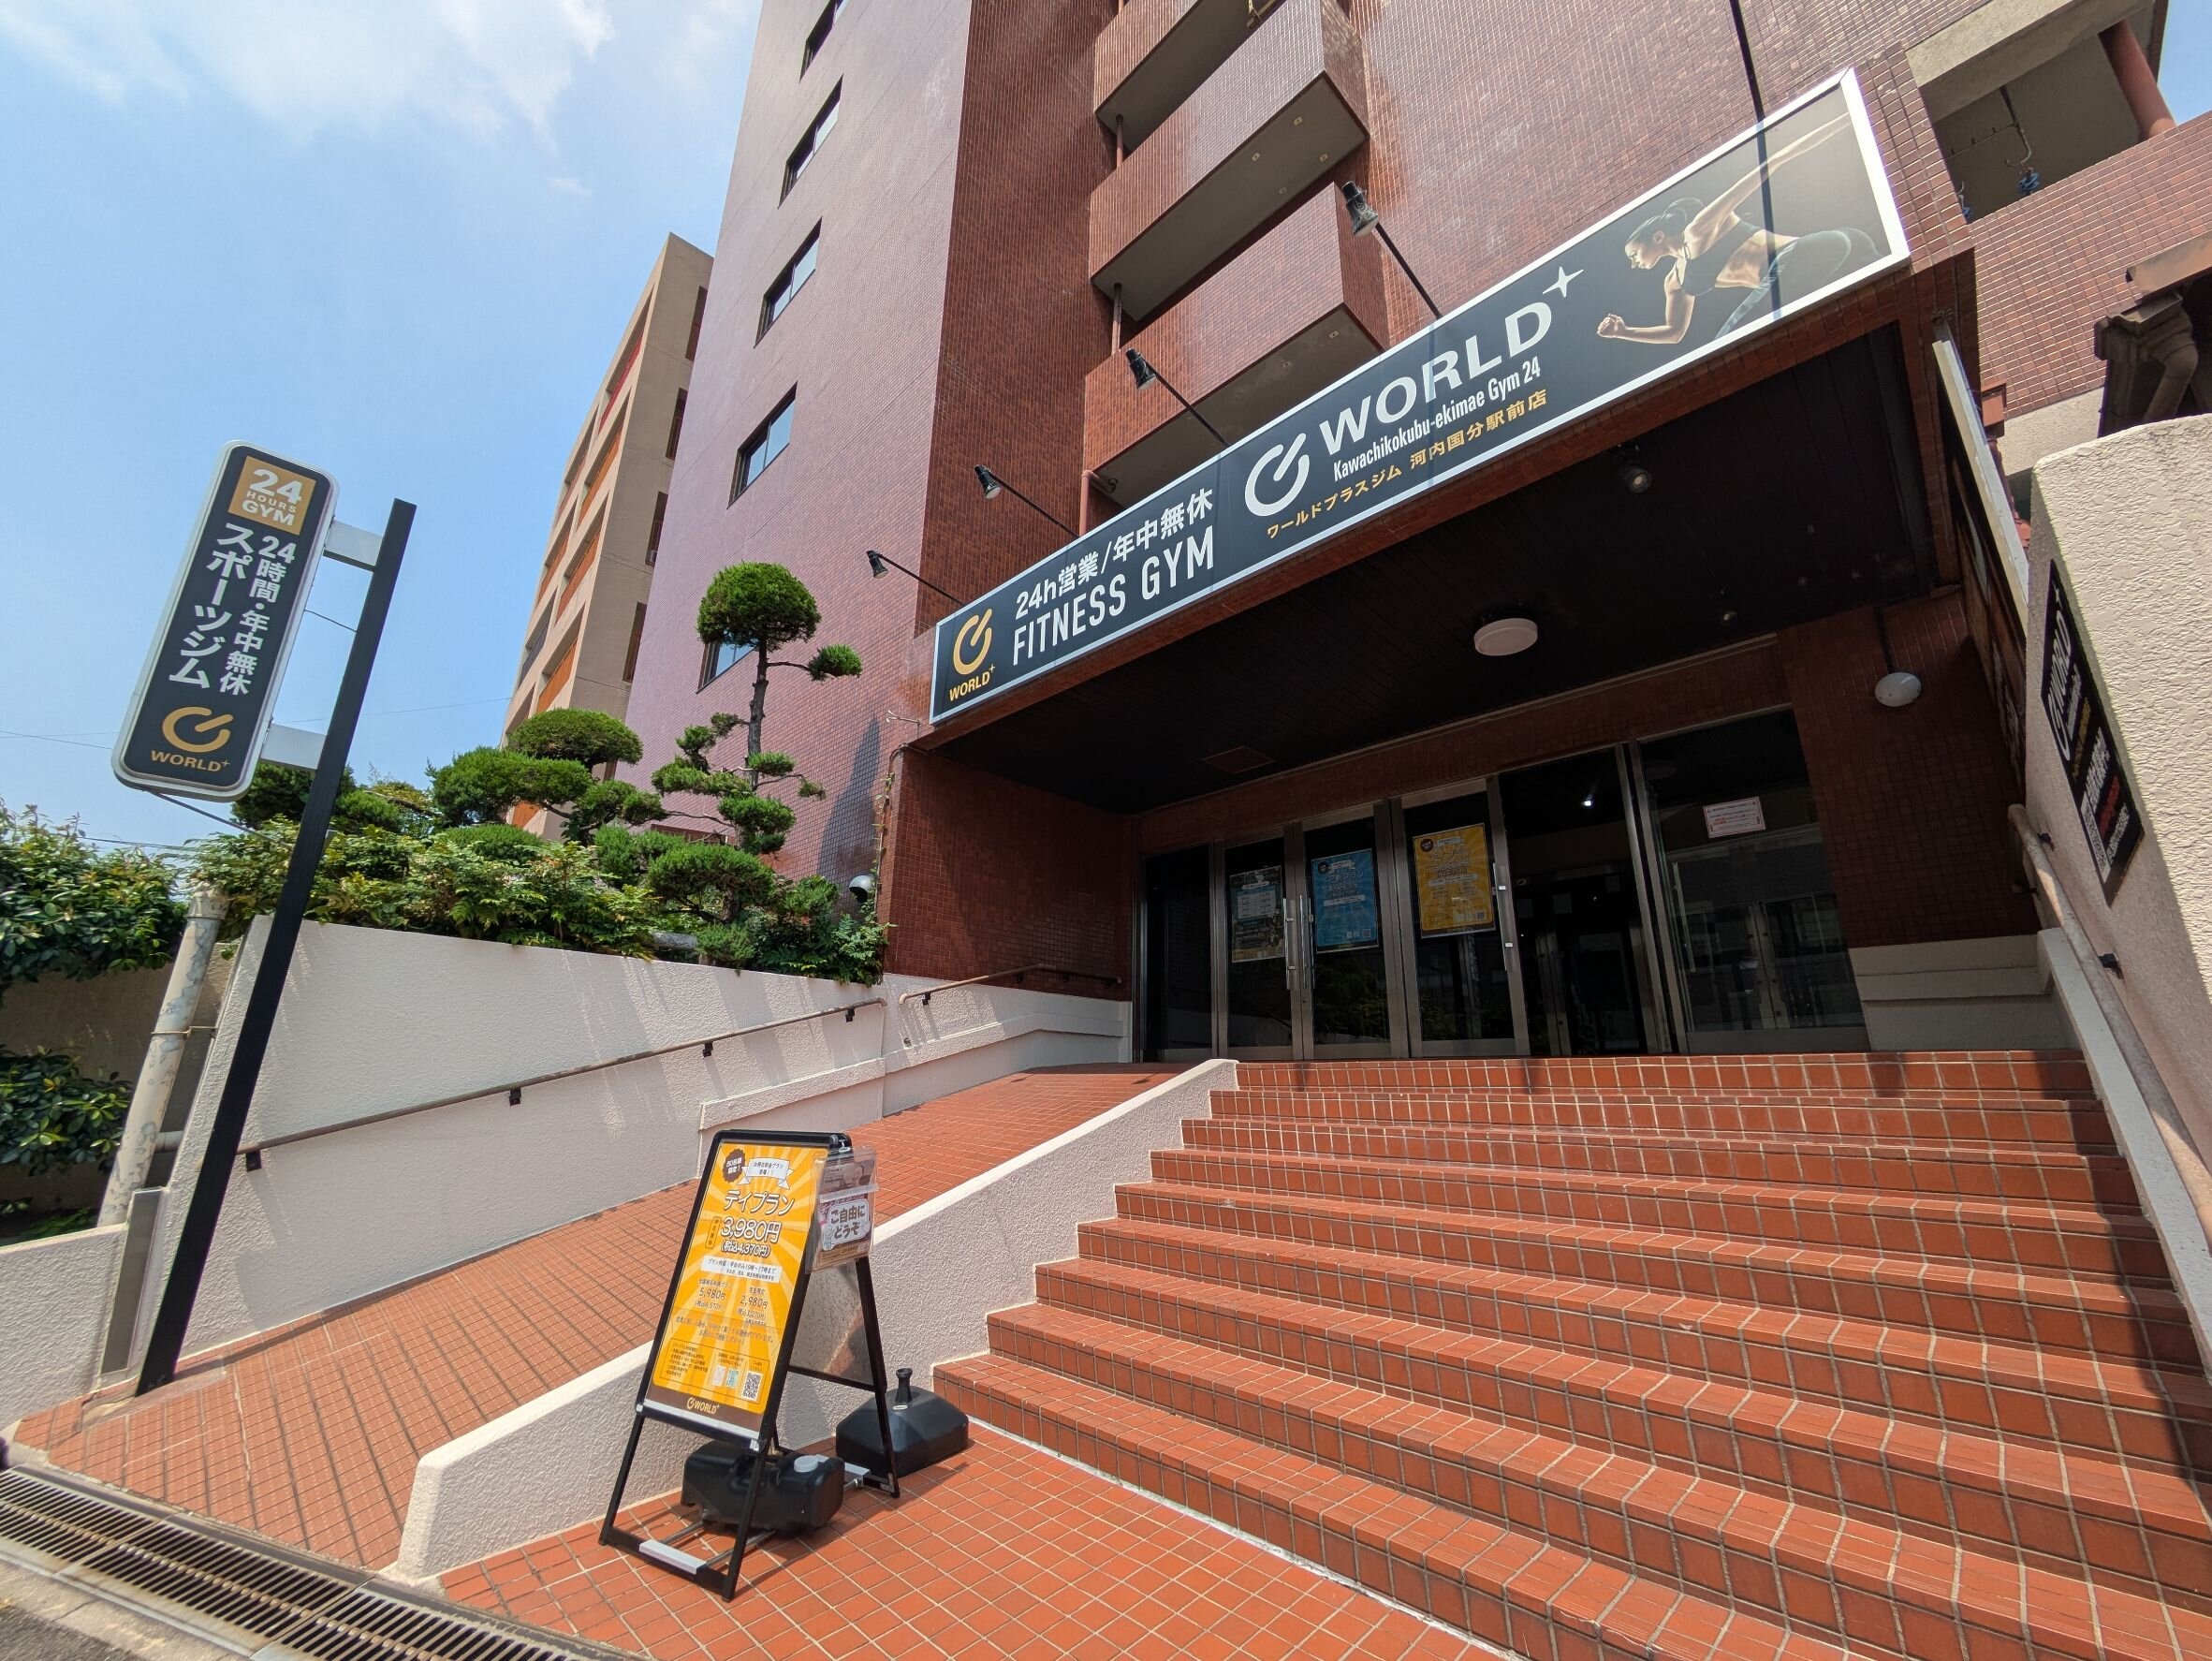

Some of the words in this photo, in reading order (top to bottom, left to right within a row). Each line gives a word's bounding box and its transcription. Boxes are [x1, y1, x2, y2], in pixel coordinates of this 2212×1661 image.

[1334, 392, 1485, 481] Kawachikokubu-ekimae
[1488, 373, 1520, 400] Gym
[1523, 357, 1541, 383] 24
[1267, 465, 1401, 538] ワールドプラスジム
[1411, 390, 1546, 469] 河内国分駅前店
[249, 469, 301, 505] 24
[242, 500, 295, 526] GYM
[246, 492, 297, 513] HOURS
[169, 522, 255, 688] スポーツジム
[1013, 574, 1126, 666] FITNESS
[1142, 526, 1214, 600] GYM
[830, 1204, 866, 1224] ご自由に
[720, 1216, 782, 1243] 3,980円
[833, 1221, 860, 1240] どうぞ
[740, 1294, 768, 1310] 2,980円
